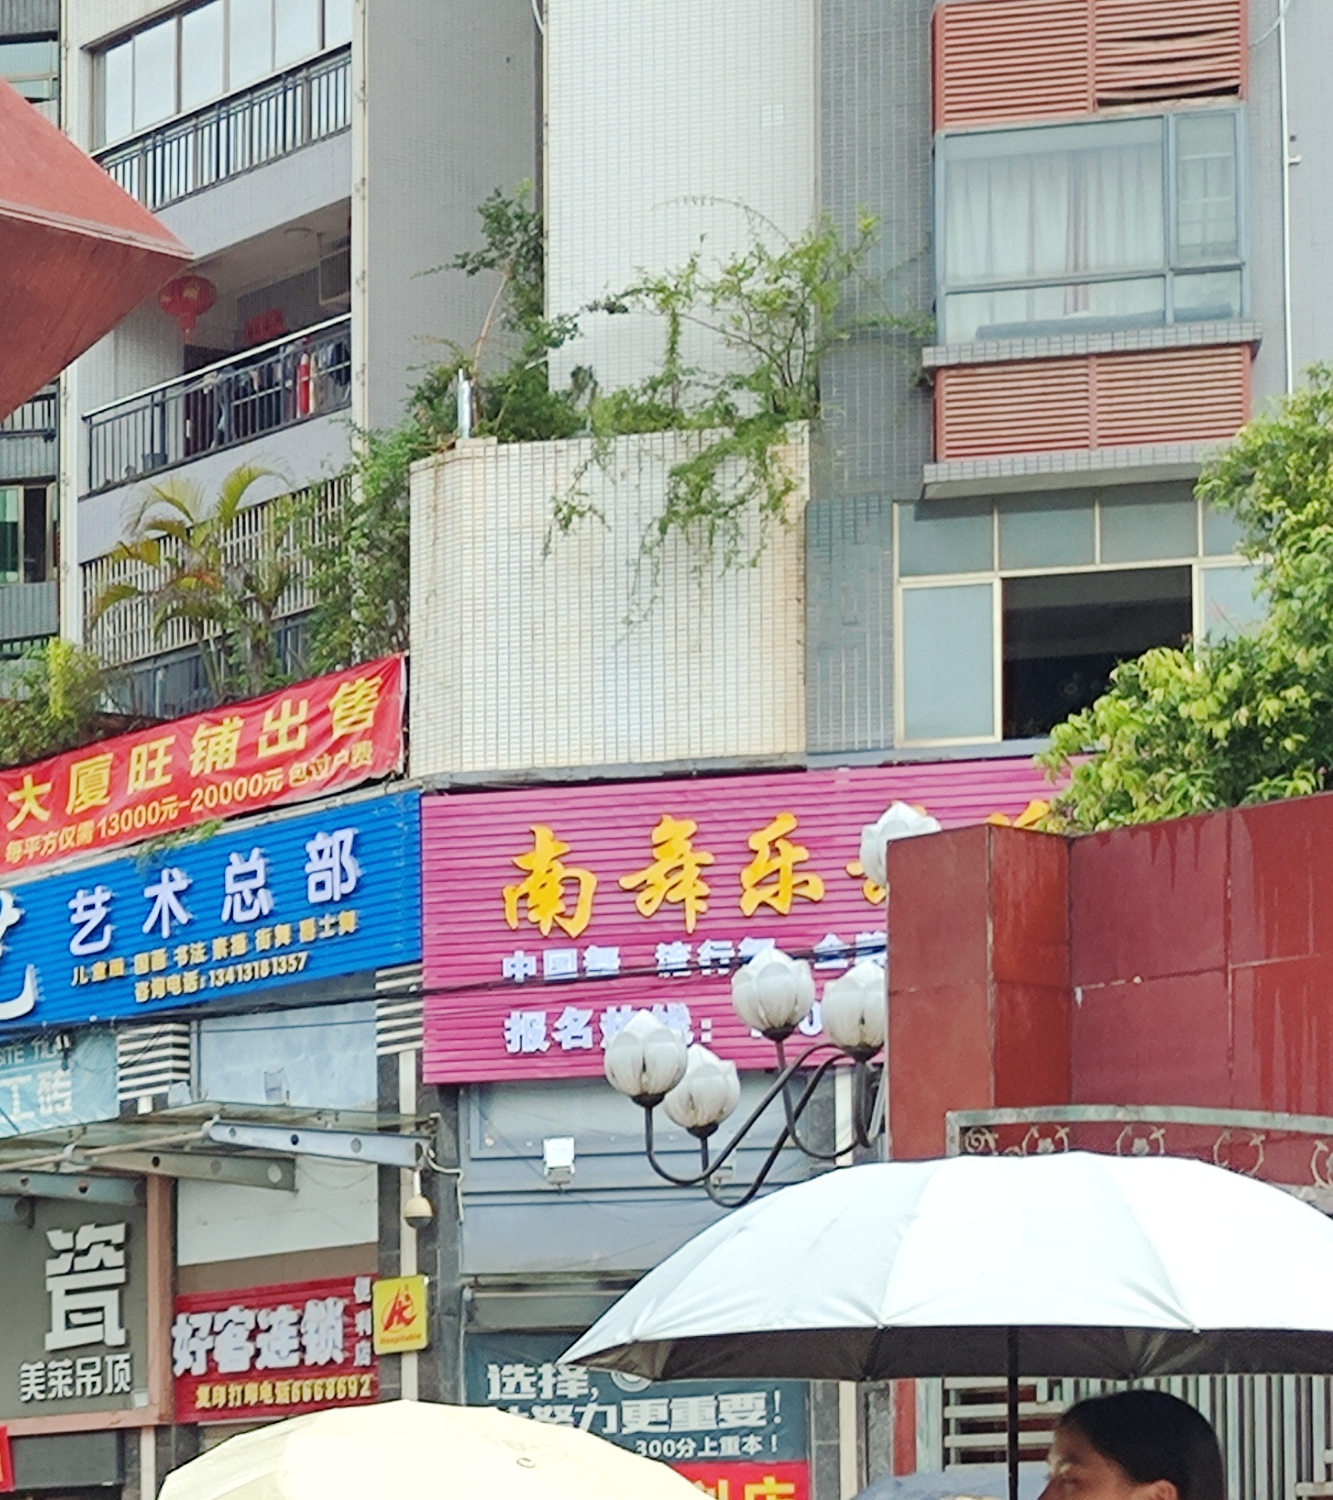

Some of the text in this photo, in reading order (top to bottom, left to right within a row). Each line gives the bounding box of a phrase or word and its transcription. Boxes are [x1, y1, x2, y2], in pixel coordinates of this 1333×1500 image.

[68, 827, 359, 956] 艺术总部
[502, 811, 887, 938] 南舞乐
[172, 1296, 346, 1378] 好客连锁
[19, 1353, 133, 1404] 美莱吊顶
[508, 1390, 783, 1436] 努力更重要!
